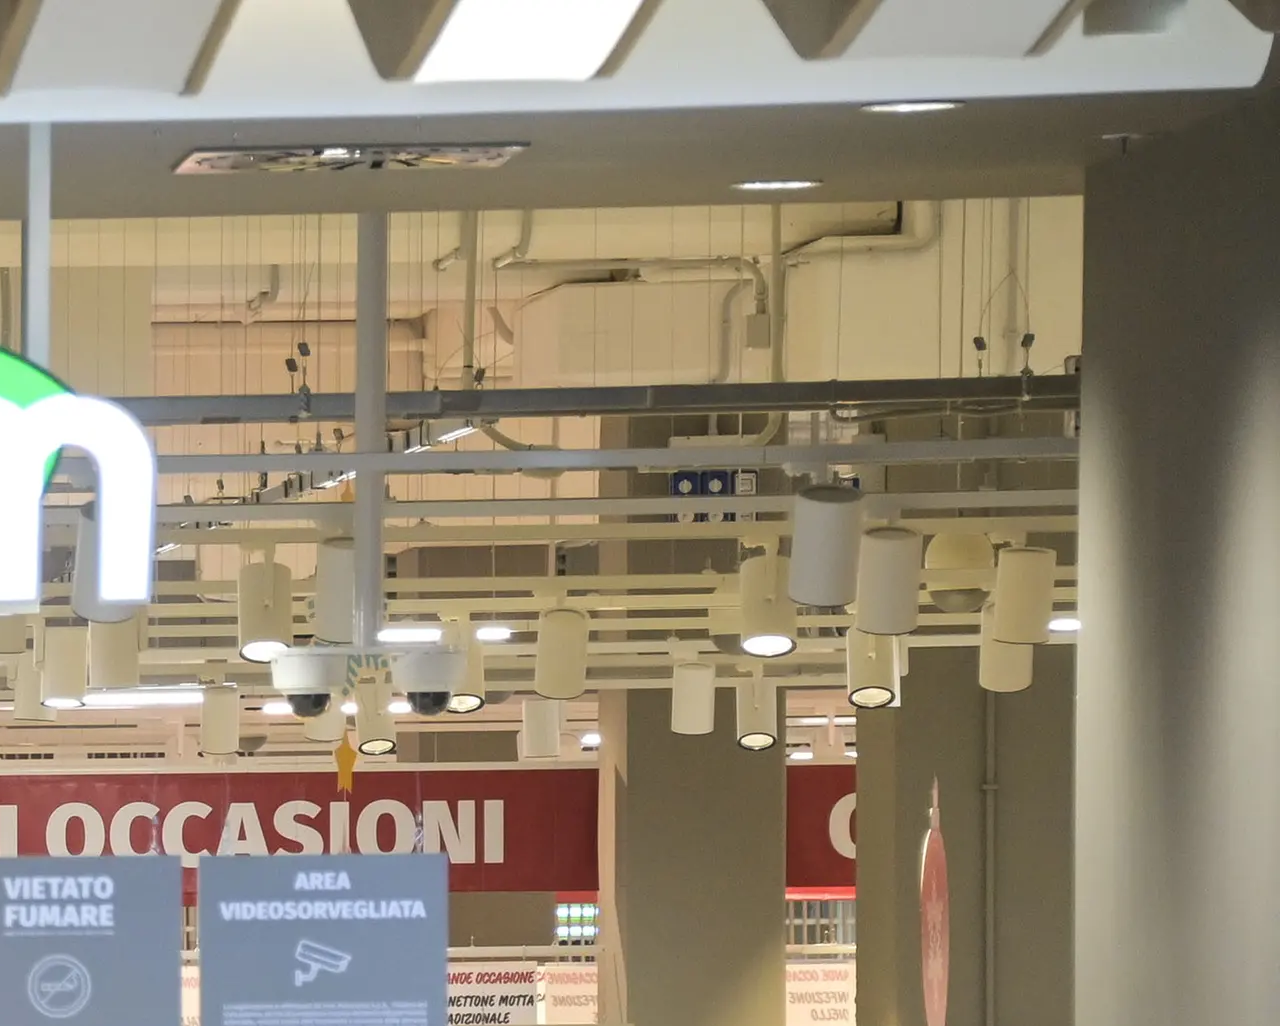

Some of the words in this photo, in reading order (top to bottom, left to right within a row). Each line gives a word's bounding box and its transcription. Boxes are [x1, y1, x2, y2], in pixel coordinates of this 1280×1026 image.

[45, 799, 504, 868] OCCASIONI
[4, 876, 115, 900] VIETATO
[294, 871, 352, 890] AREA
[4, 904, 115, 928] FUMARE
[219, 900, 427, 921] VIDEOSORVEGLIATA
[476, 971, 535, 984] OCCASIONE
[448, 994, 496, 1007] NETTONE
[498, 994, 534, 1006] MOTTA
[448, 1012, 510, 1024] ADIZIONALE
